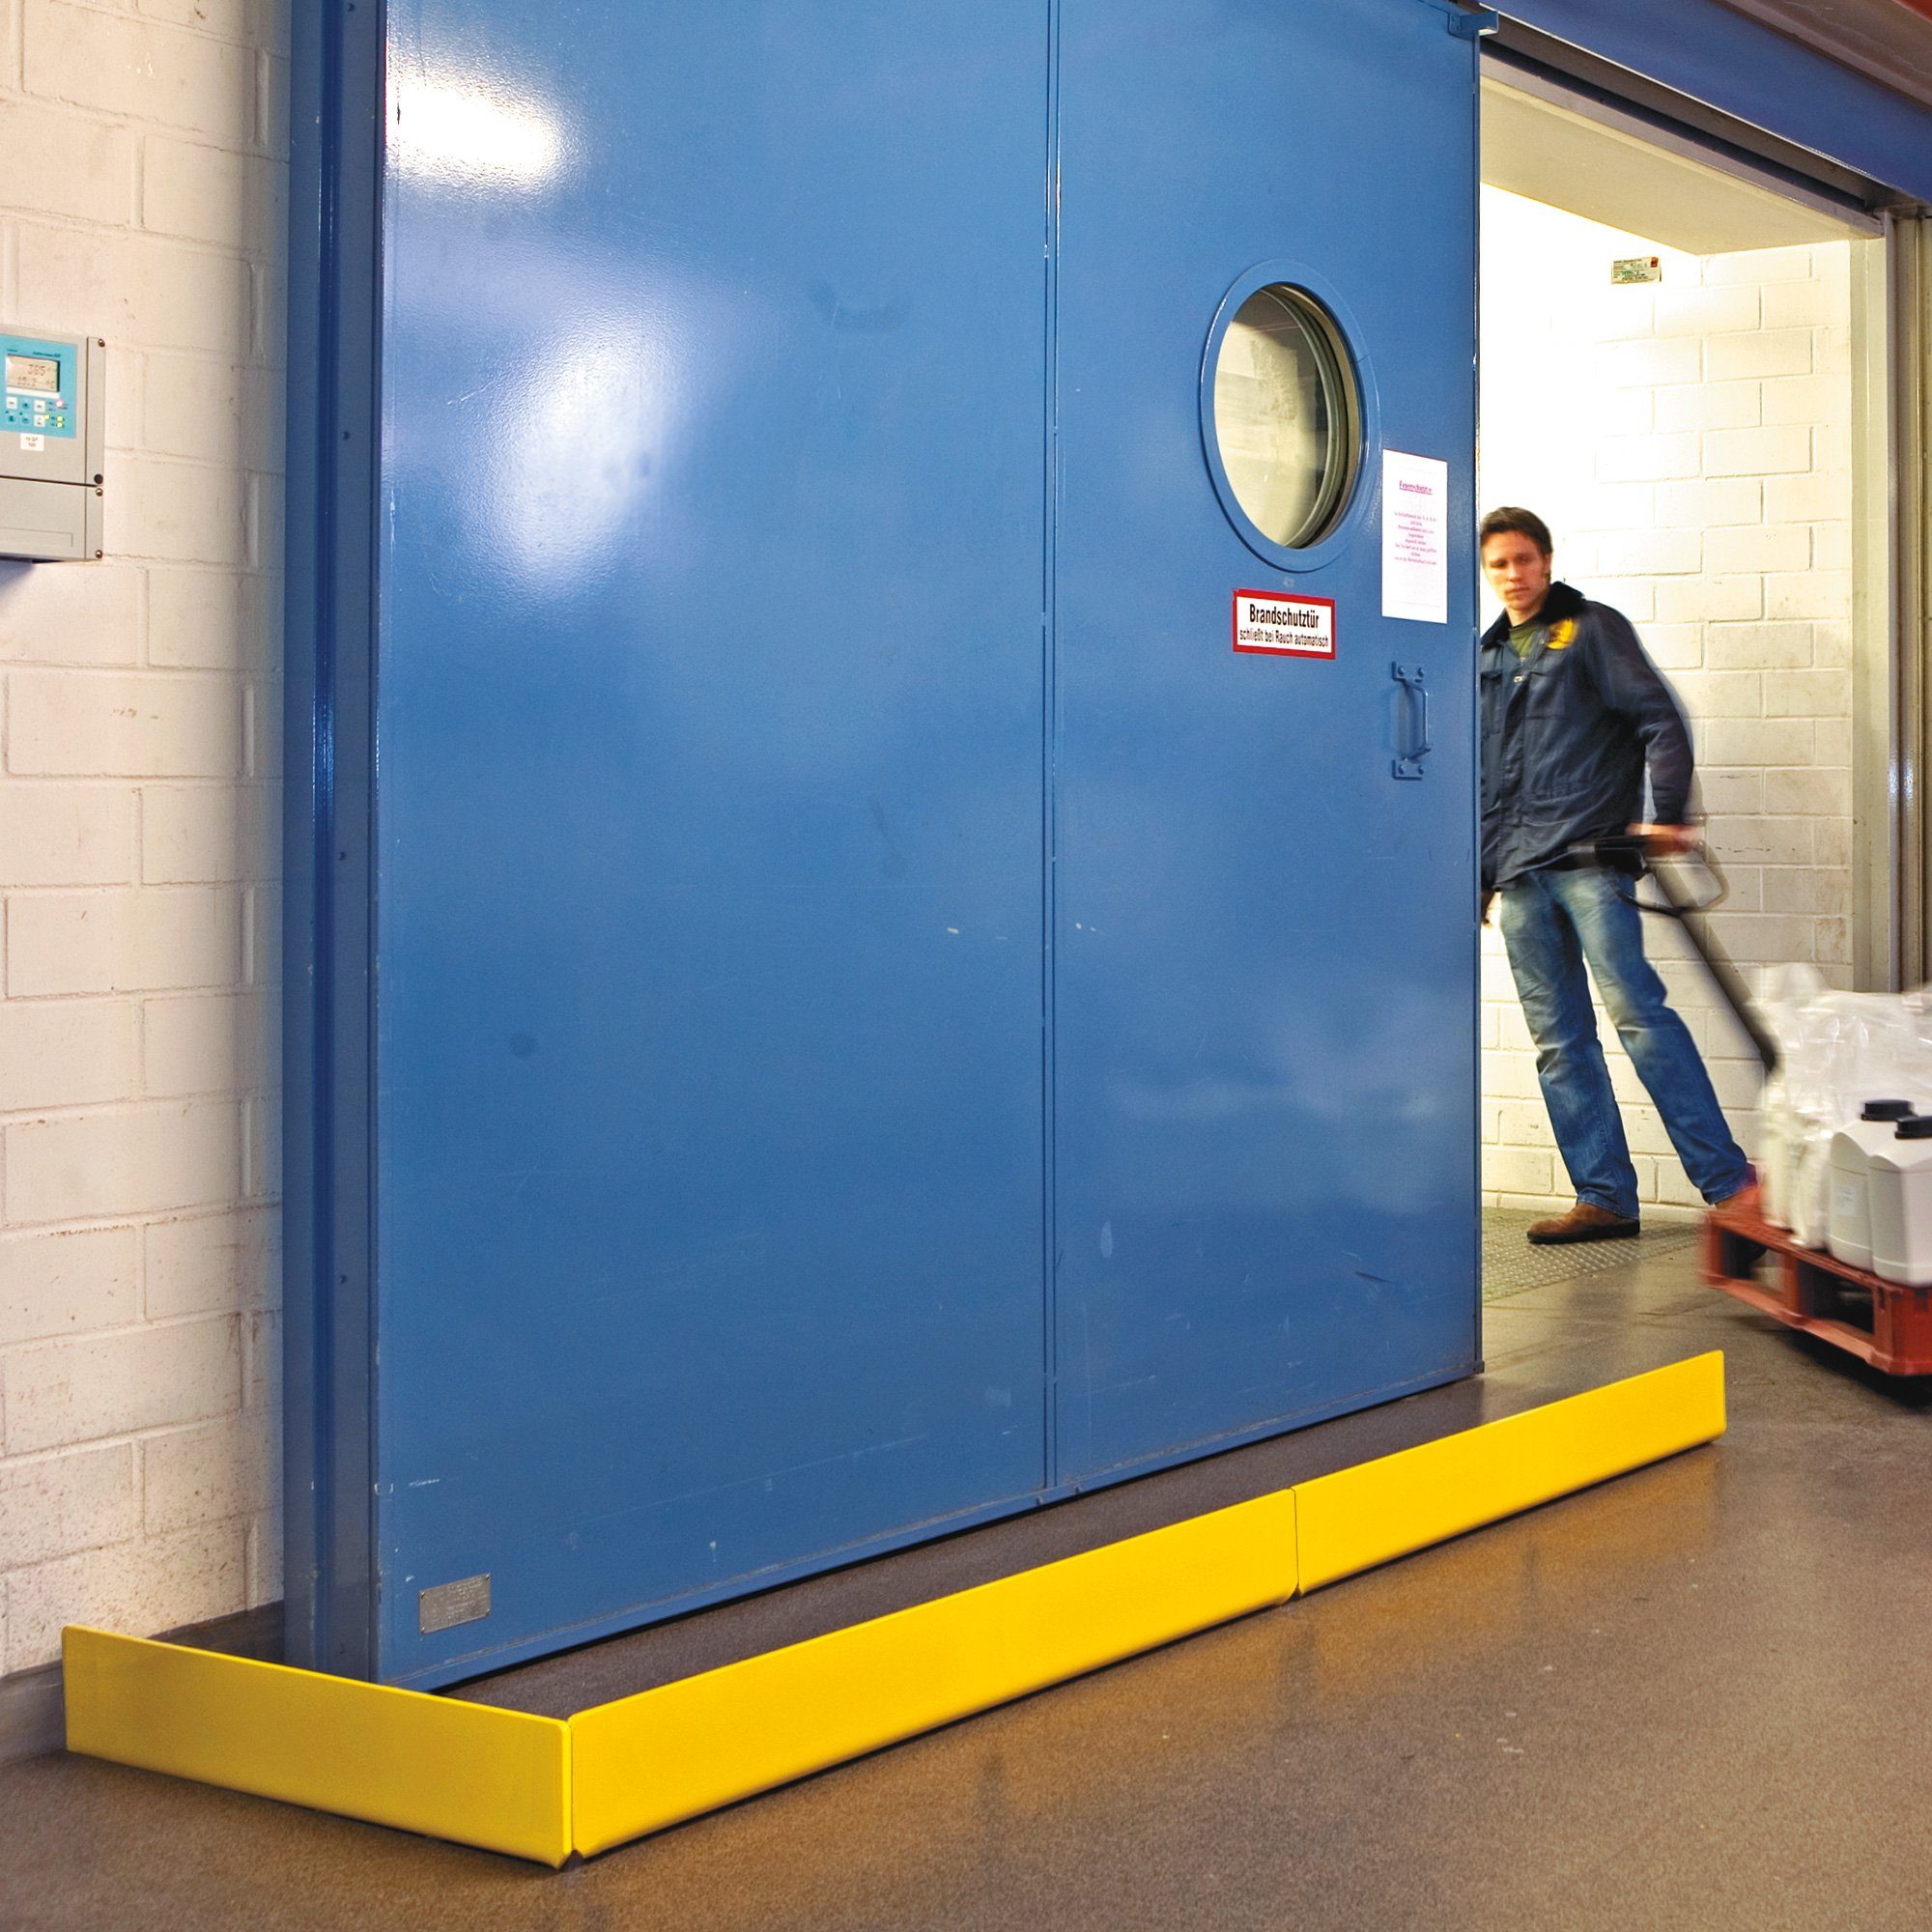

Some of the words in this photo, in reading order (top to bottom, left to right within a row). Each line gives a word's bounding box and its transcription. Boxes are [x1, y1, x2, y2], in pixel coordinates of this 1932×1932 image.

[1249, 603, 1320, 629] Brandschutztür
[1239, 628, 1264, 640] schließt
[1264, 629, 1274, 642] bei
[1275, 630, 1293, 644] Rauch
[1294, 634, 1328, 647] automatisch
